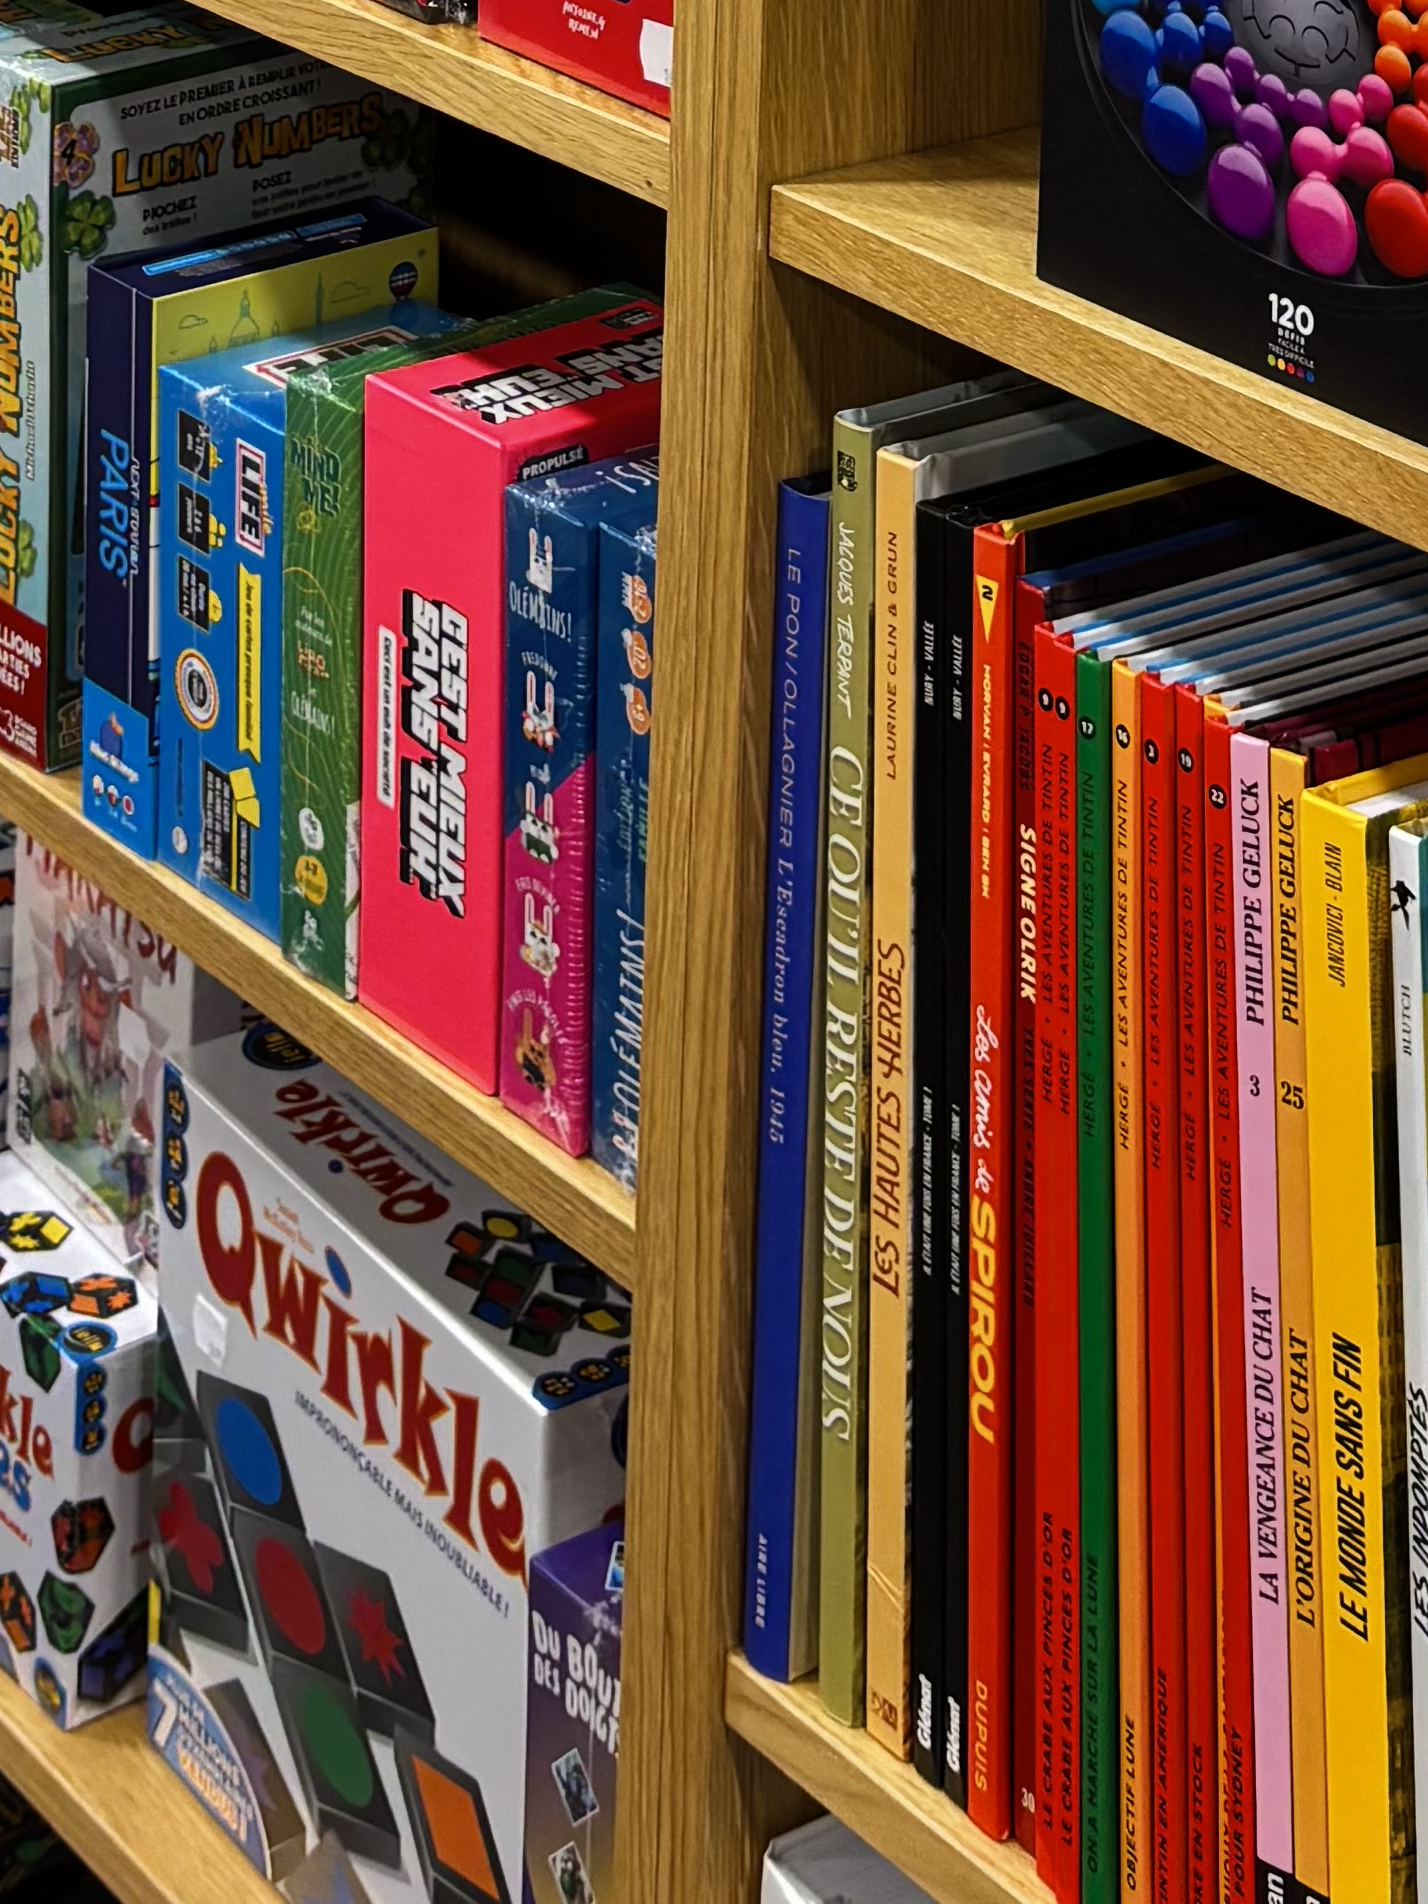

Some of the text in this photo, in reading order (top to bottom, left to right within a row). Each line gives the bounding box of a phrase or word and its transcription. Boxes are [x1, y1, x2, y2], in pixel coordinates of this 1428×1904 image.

[1267, 291, 1315, 337] 120
[829, 745, 864, 826] CE
[1239, 777, 1265, 1027] PHILIPPE GELUCK
[825, 998, 858, 1181] RESTE
[876, 941, 905, 1079] HERBES
[824, 1187, 854, 1271] DE
[873, 1086, 902, 1228] HAUTES
[196, 1151, 528, 1592] Qwirkle
[822, 1273, 853, 1442] NOUS
[969, 1194, 998, 1445] SPIROU
[1250, 1287, 1279, 1606] LA VENGEANCE DU CHAT
[1331, 1331, 1369, 1643] LE MONDE SANS FIN
[393, 1489, 424, 1532] MAIS
[423, 1520, 503, 1613] INOUBLIABLE
